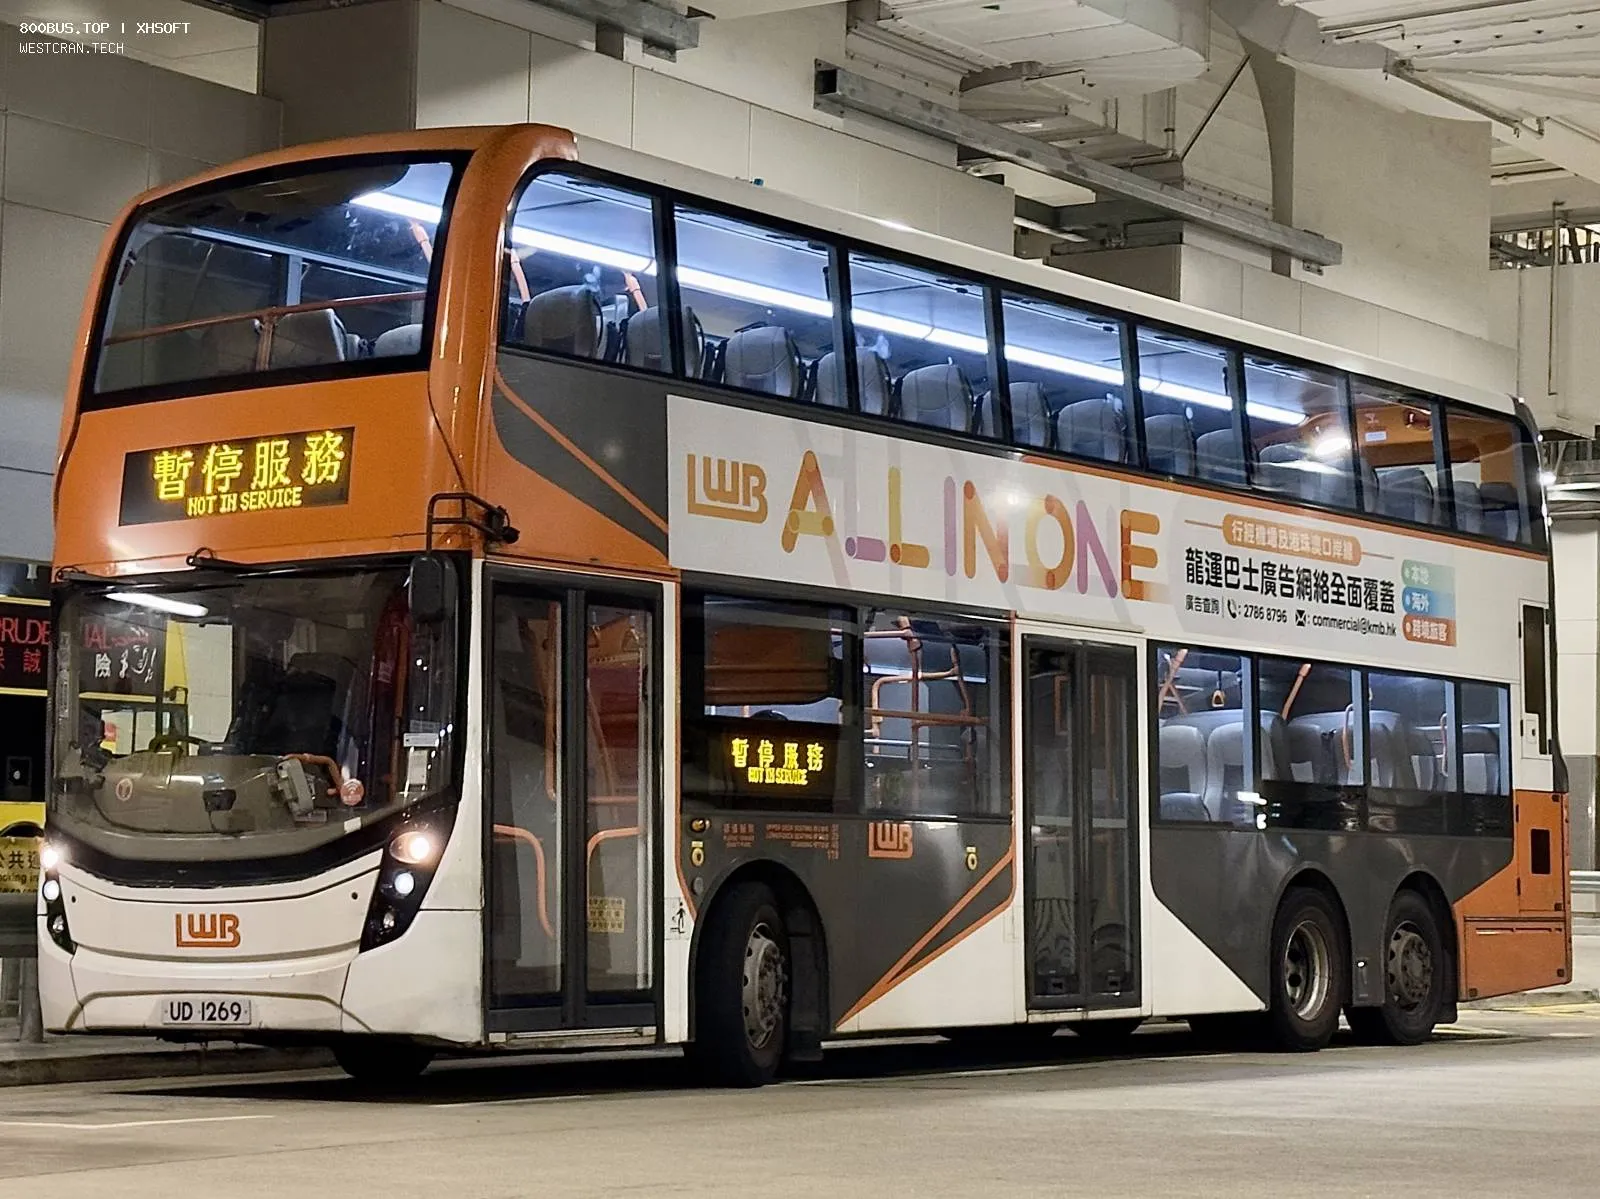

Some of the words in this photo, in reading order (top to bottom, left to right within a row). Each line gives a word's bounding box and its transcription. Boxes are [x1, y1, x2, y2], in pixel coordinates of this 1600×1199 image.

[153, 430, 346, 501] 暫停服務
[187, 495, 218, 517] NOT
[219, 493, 238, 513] IN
[239, 487, 303, 511] SERVICE
[686, 453, 768, 524] LWB
[1185, 547, 1396, 615] 龍運巴士廣告網絡全面覆蓋
[1243, 603, 1265, 622] 2786
[1266, 607, 1288, 624] 8796
[1312, 613, 1397, 638] commercial@kmb.hk
[0, 617, 51, 645] RUDE
[731, 738, 825, 772] 暫停服務
[868, 822, 914, 859] LWB
[175, 913, 241, 948] LWB
[169, 1001, 194, 1021] UD
[201, 1001, 242, 1021] 1269
